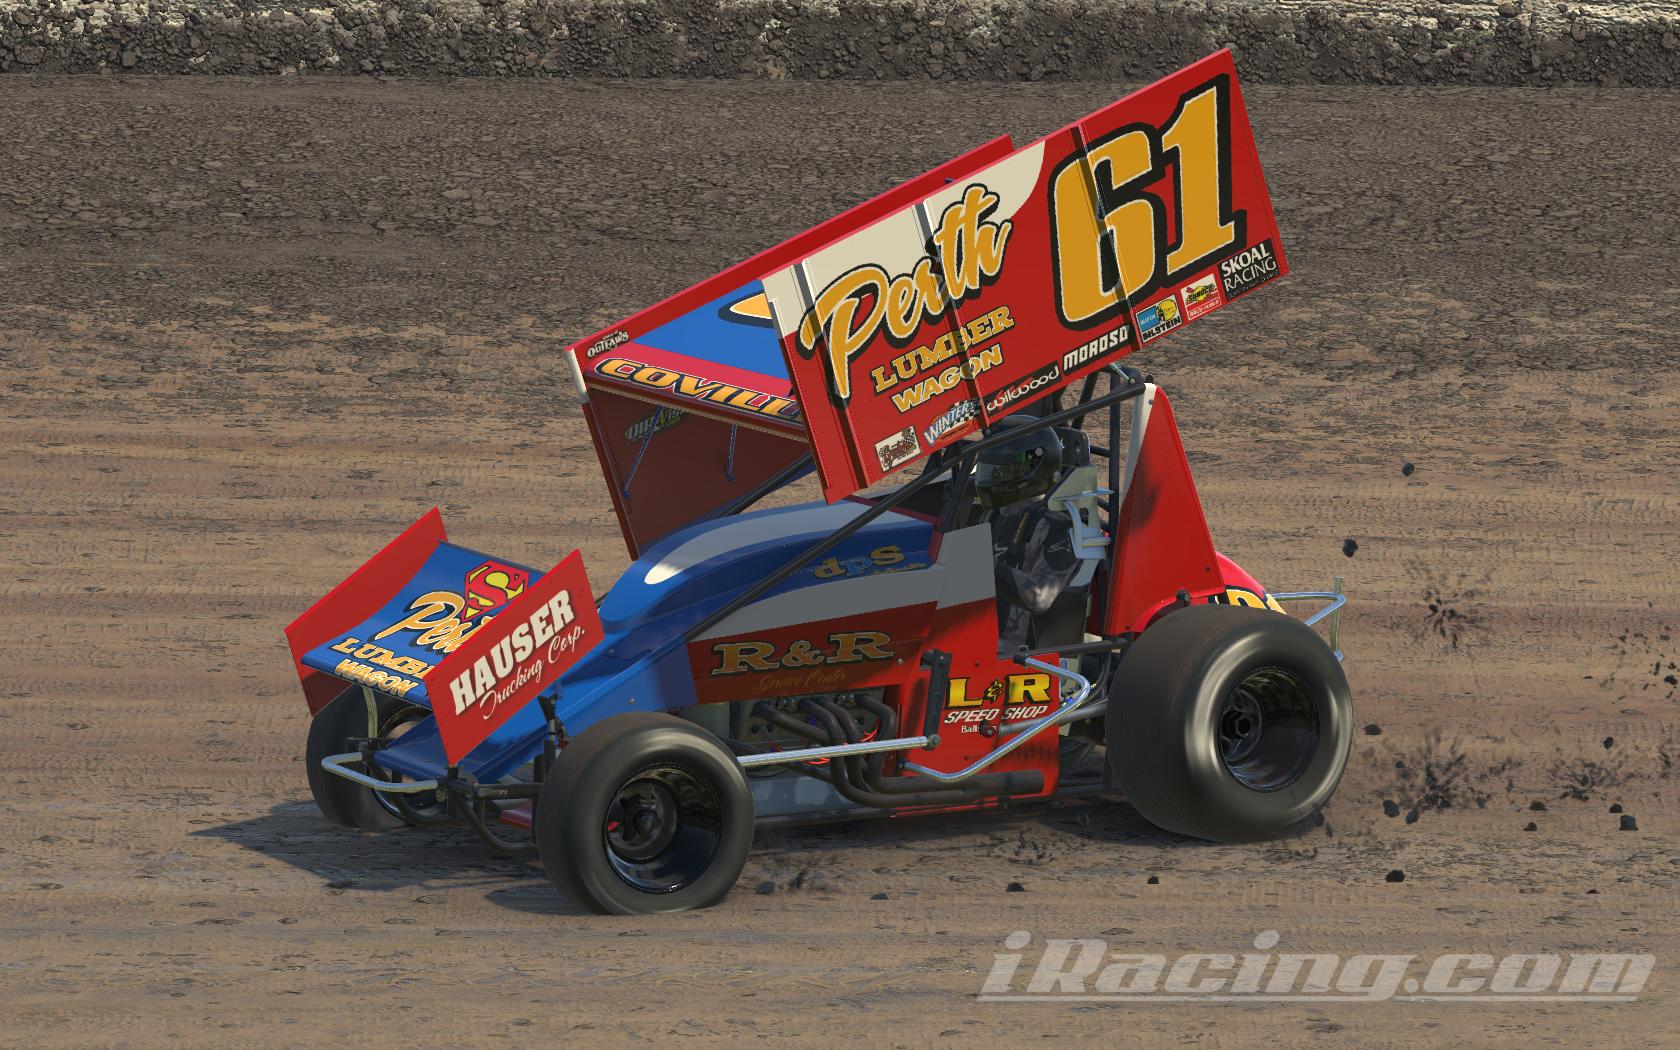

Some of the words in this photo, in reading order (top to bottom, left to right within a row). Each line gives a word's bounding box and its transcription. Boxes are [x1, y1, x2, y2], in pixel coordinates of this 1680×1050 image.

[1050, 76, 1244, 329] 61
[1221, 242, 1270, 277] SKOAL
[1223, 256, 1277, 292] RACING
[798, 183, 1013, 403] Perth
[1187, 283, 1215, 302] SUNOCO
[871, 306, 1015, 392] LUMBER
[1063, 325, 1129, 372] MOROSO
[1142, 316, 1181, 341] BILSTEIN
[594, 357, 803, 425] COVILL
[891, 343, 1004, 412] WAGON
[986, 364, 1060, 412] wilwood
[331, 637, 437, 679] LUMB
[449, 588, 575, 716] HAUSER
[479, 658, 544, 720] Trucking
[547, 625, 586, 665] Corp.
[710, 631, 895, 676] R&R
[334, 658, 419, 698] WAGON
[944, 708, 1000, 724] SPEED
[1001, 705, 1048, 720] SHOP
